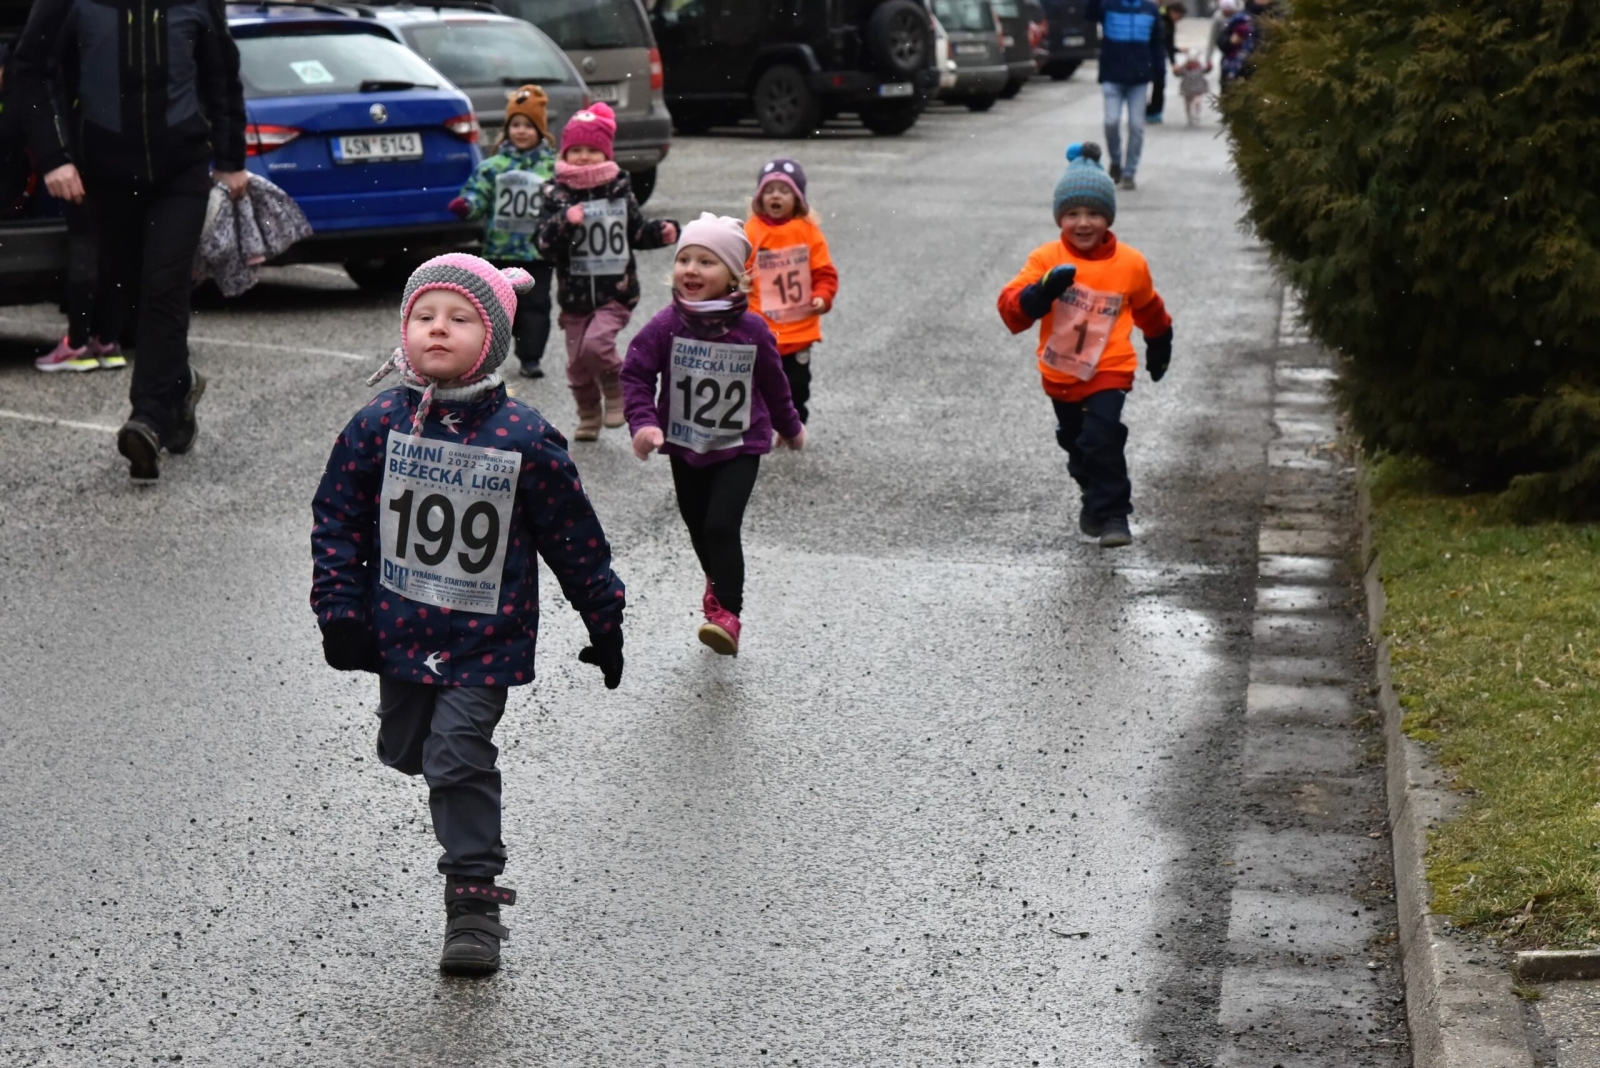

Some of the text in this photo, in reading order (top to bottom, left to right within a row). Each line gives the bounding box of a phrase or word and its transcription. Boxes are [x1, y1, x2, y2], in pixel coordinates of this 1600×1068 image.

[344, 136, 415, 155] 4SN 6143
[499, 188, 541, 218] 209
[572, 221, 625, 257] 206
[772, 270, 803, 305] 15
[675, 343, 713, 358] ZIMNÍ
[1073, 320, 1088, 355] 1
[674, 354, 725, 373] BĚŽECKÁ
[730, 362, 751, 374] LIGA
[676, 375, 746, 430] 122
[391, 440, 444, 463] ZIMNÍ
[389, 458, 511, 492] BĚŽECKÁ LIGA
[389, 489, 500, 574] 199
[411, 569, 442, 582] VYRÁBÍME
[444, 577, 477, 588] STARTOVNÍ
[479, 581, 496, 590] ČÍSLA
